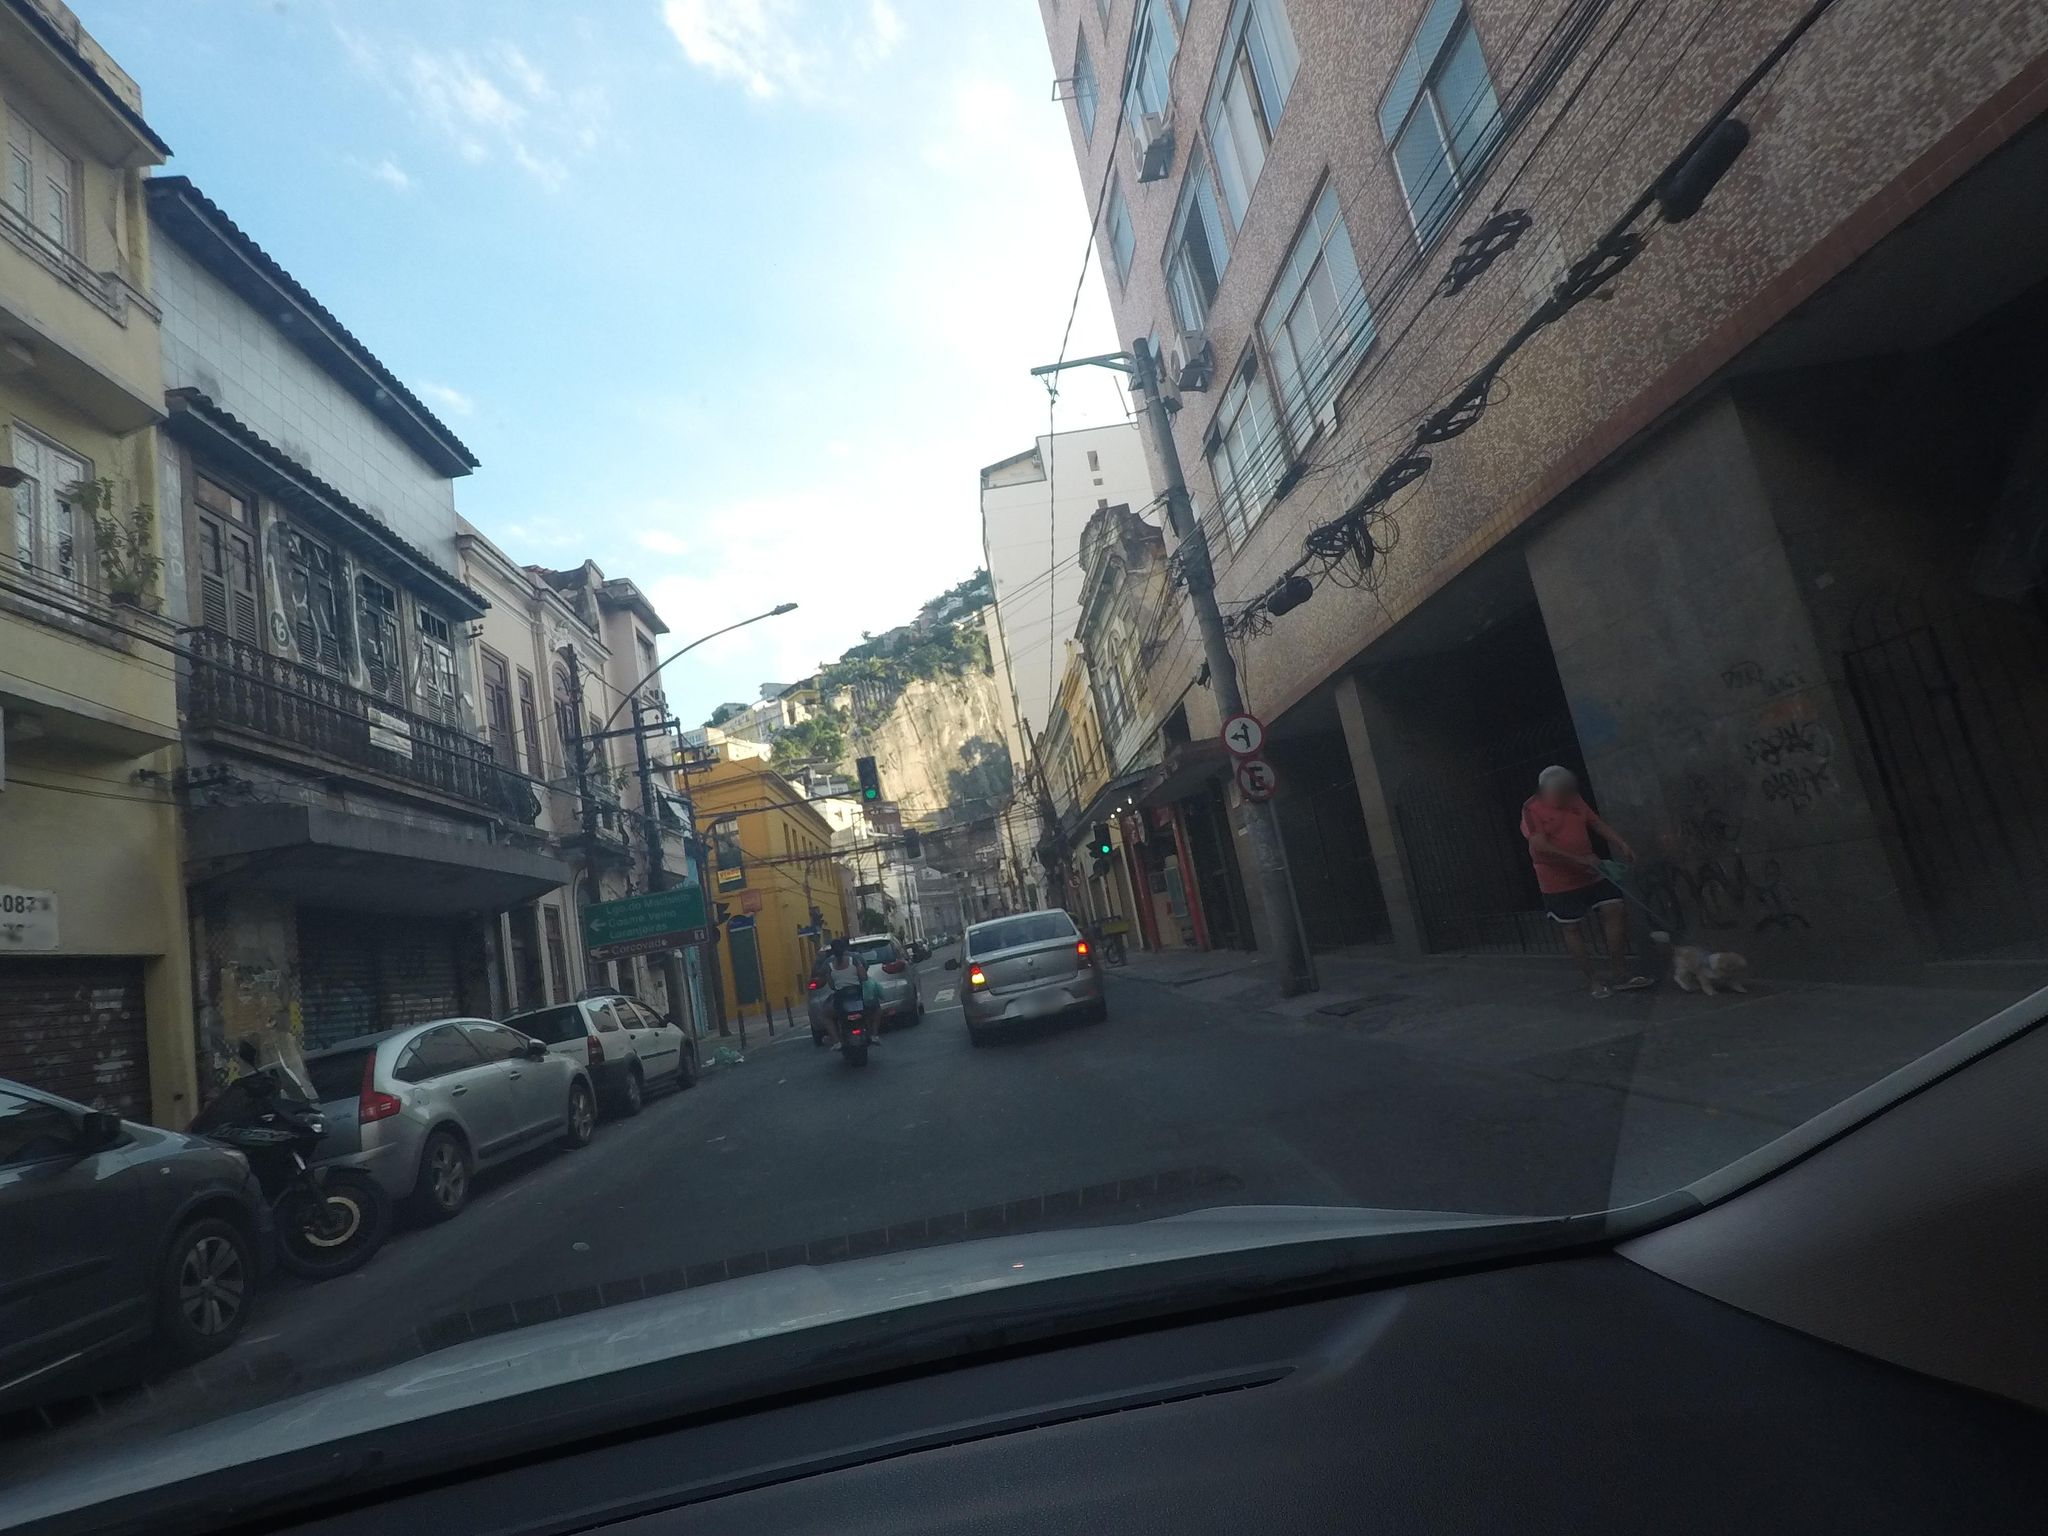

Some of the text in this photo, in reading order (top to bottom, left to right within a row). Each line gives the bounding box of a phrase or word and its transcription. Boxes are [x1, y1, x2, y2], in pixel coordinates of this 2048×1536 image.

[1248, 766, 1265, 791] E
[608, 910, 677, 928] Cosme Velho
[609, 923, 668, 939] Laranjeiras
[611, 939, 669, 955] Corcovado
